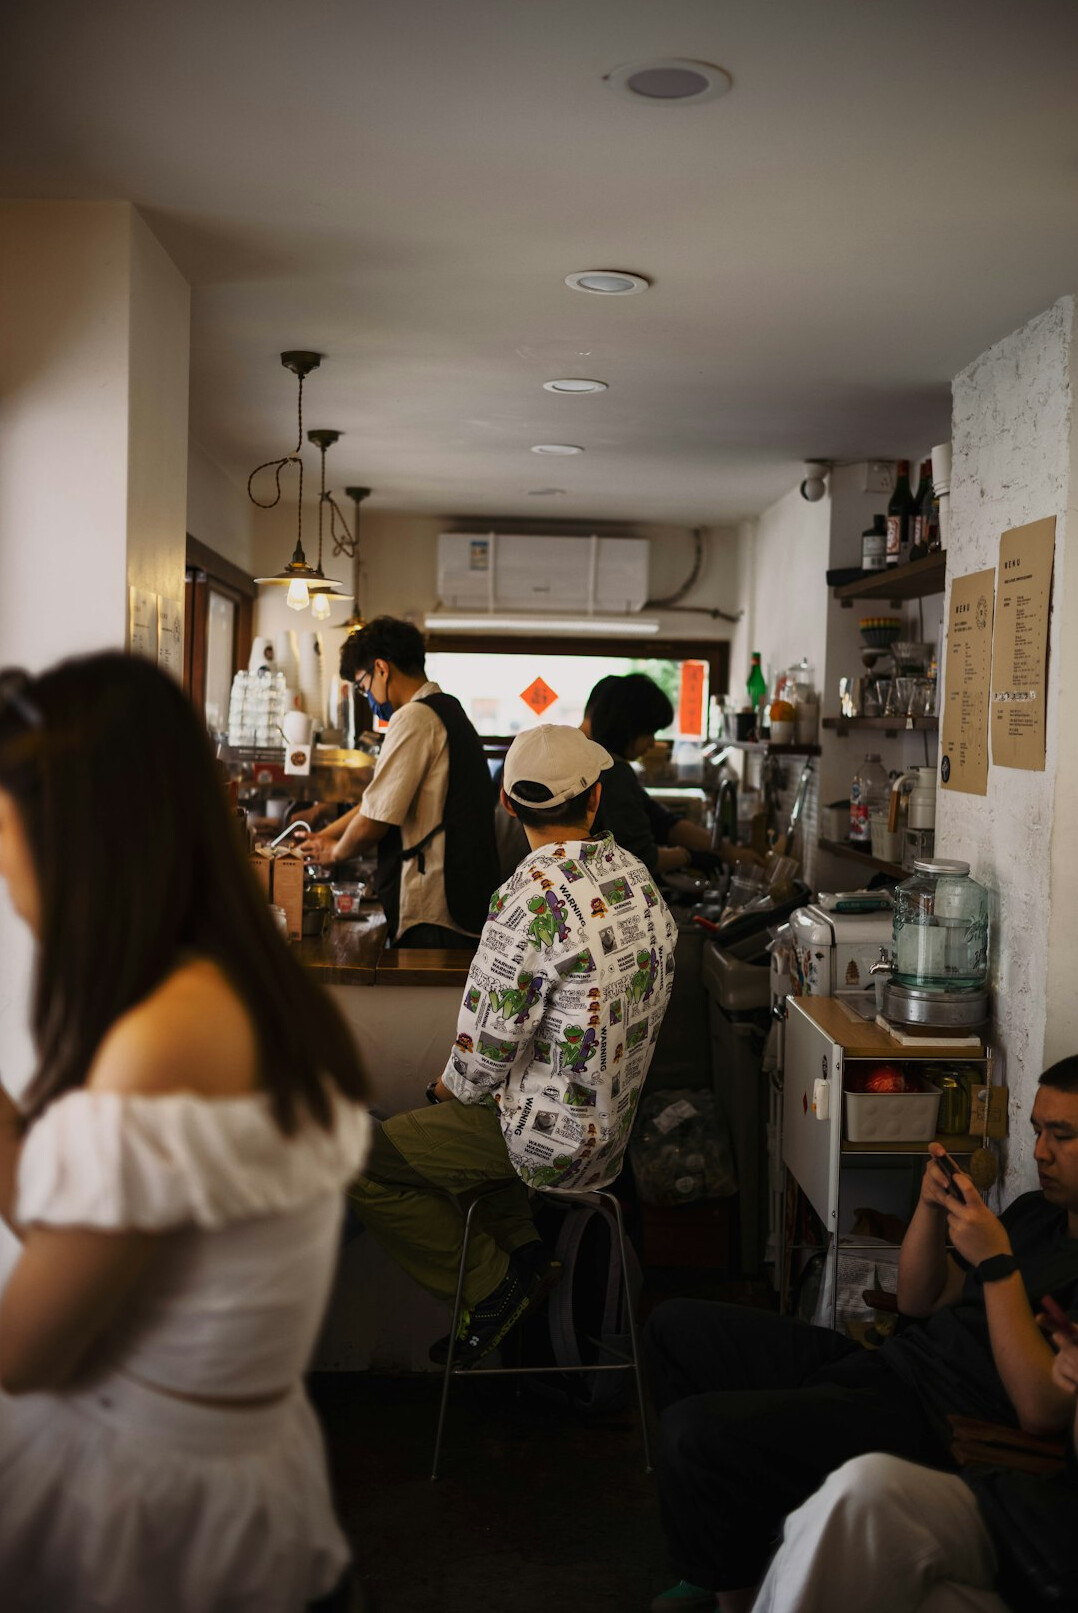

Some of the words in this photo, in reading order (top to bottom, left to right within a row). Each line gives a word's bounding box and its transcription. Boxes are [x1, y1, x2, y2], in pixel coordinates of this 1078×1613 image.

[559, 884, 586, 927] WARNING
[505, 906, 521, 924] ARNING
[508, 909, 524, 928] ARNING
[492, 962, 516, 976] WARNING
[494, 957, 517, 972] WARNING
[490, 967, 514, 981] WARNING
[481, 1003, 491, 1028] WARNING
[481, 1057, 506, 1068] WARNING
[515, 1097, 533, 1136] WARNING
[526, 1144, 552, 1157] WARNING
[528, 1139, 554, 1153] WARNING
[524, 1148, 550, 1161] WARNING
